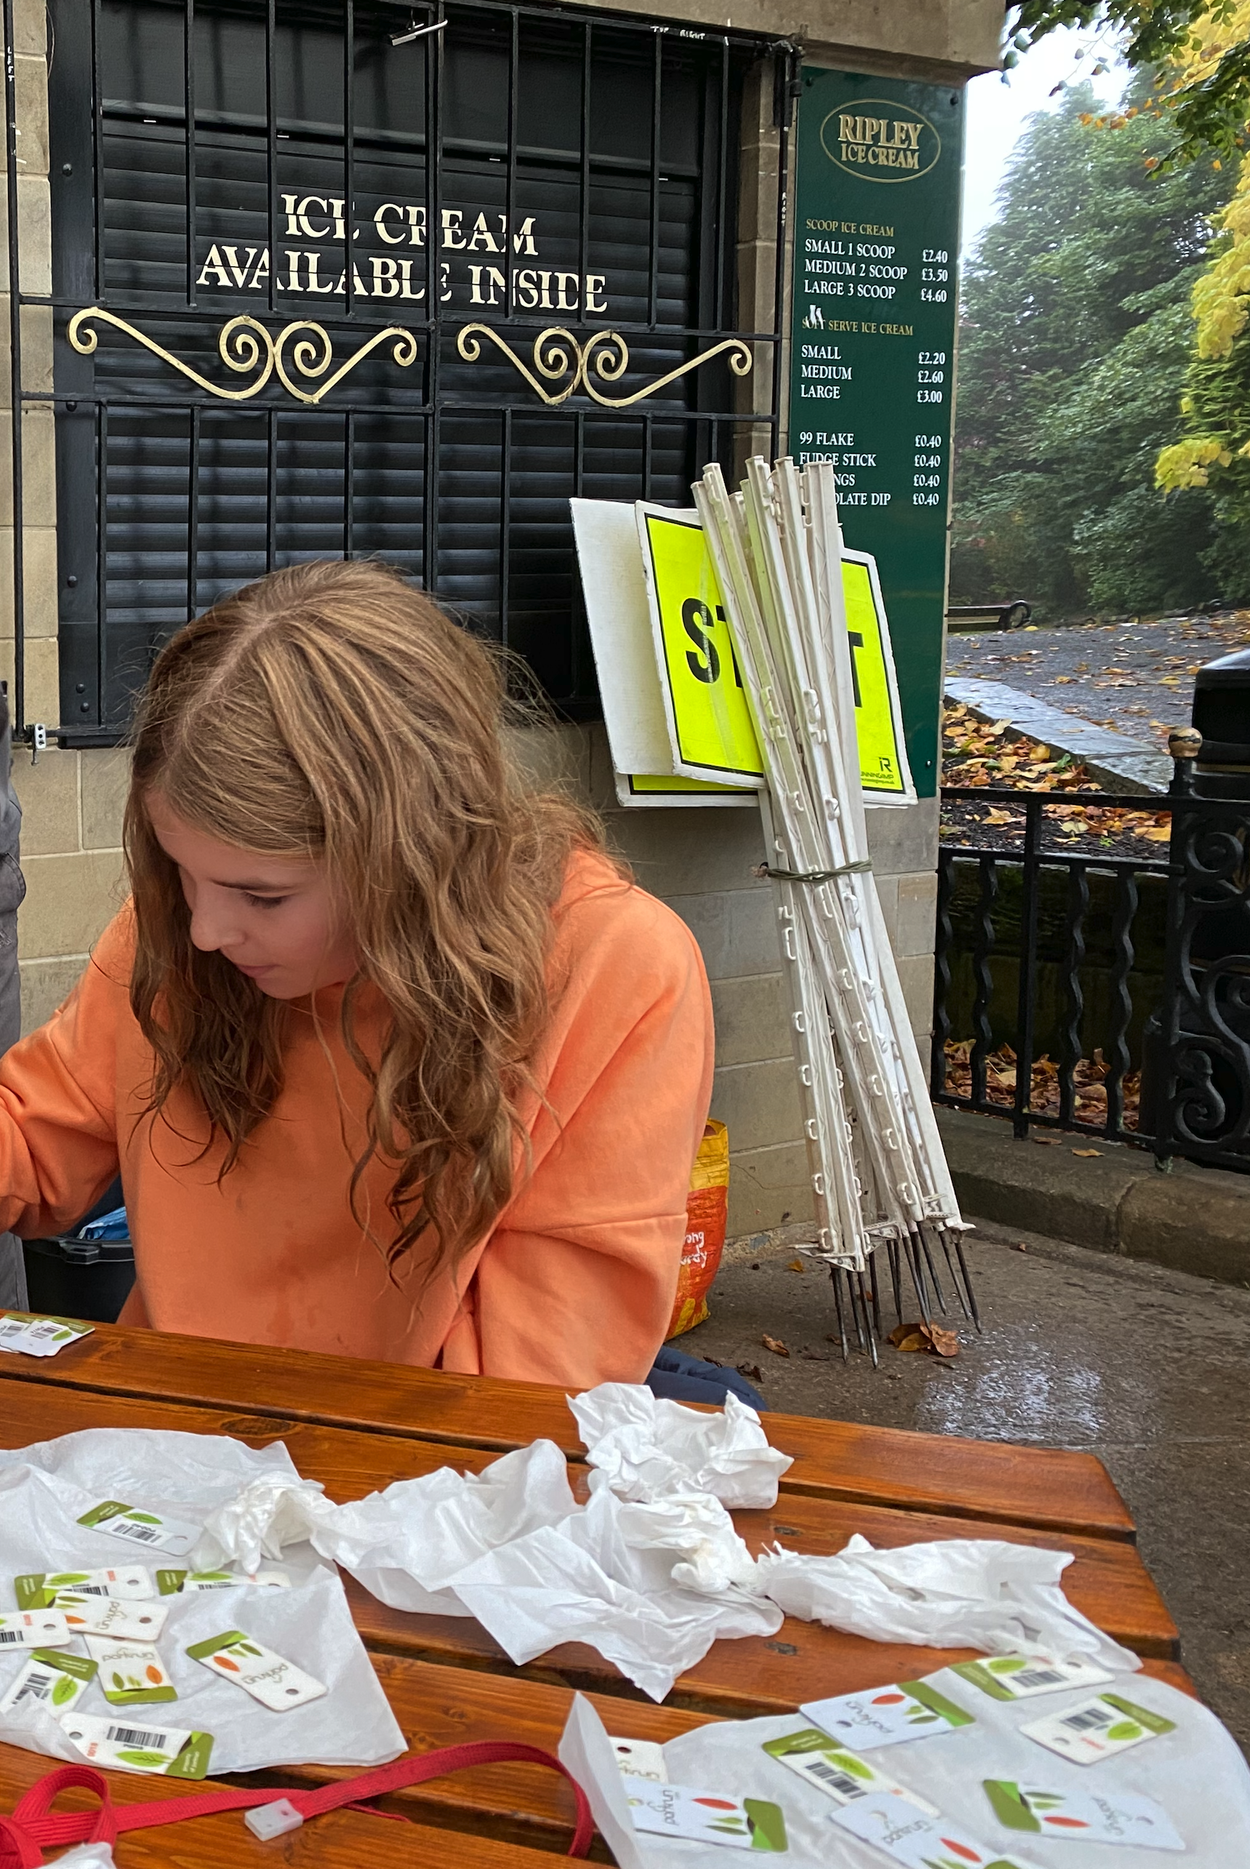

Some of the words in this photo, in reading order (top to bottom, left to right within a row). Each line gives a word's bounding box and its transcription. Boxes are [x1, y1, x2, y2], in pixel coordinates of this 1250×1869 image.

[838, 114, 924, 149] RIPLEY
[841, 143, 866, 164] ICE
[868, 146, 920, 169] CREAM
[374, 203, 539, 256] CREAM
[806, 218, 839, 232] SCOOP
[841, 221, 857, 233] ICE
[859, 224, 894, 237] CREAM
[805, 238, 845, 255] SMALL
[856, 243, 896, 259] SCOOP
[922, 249, 948, 264] £2.40
[196, 243, 451, 302] AVAILABLE
[468, 265, 608, 312] INSIDE
[804, 259, 856, 276] MEDIUM
[859, 264, 866, 277] 2
[869, 264, 908, 280] SCOOP
[921, 268, 949, 282] £3.50
[804, 279, 845, 296] LARGE
[847, 283, 854, 296] 3
[857, 284, 896, 299] SCOOP
[920, 288, 947, 303] £4.60
[828, 319, 859, 332] SERVE
[861, 322, 877, 334] ICE
[880, 323, 914, 336] CREAM
[801, 344, 841, 360] SMALL
[918, 351, 946, 365] £2.20
[801, 364, 852, 380] MEDIUM
[917, 370, 944, 383] £2.60
[800, 384, 841, 399] LARGE
[917, 390, 943, 403] £3.00
[800, 431, 813, 444] 99
[816, 432, 854, 446] FLAKE
[915, 434, 942, 448] £0.40
[842, 453, 877, 467] STICK
[914, 454, 941, 468] £0.40
[913, 474, 940, 487] £0.40
[871, 493, 892, 506] DIP
[912, 492, 940, 506] £0.40
[102, 1647, 155, 1662] parkrun
